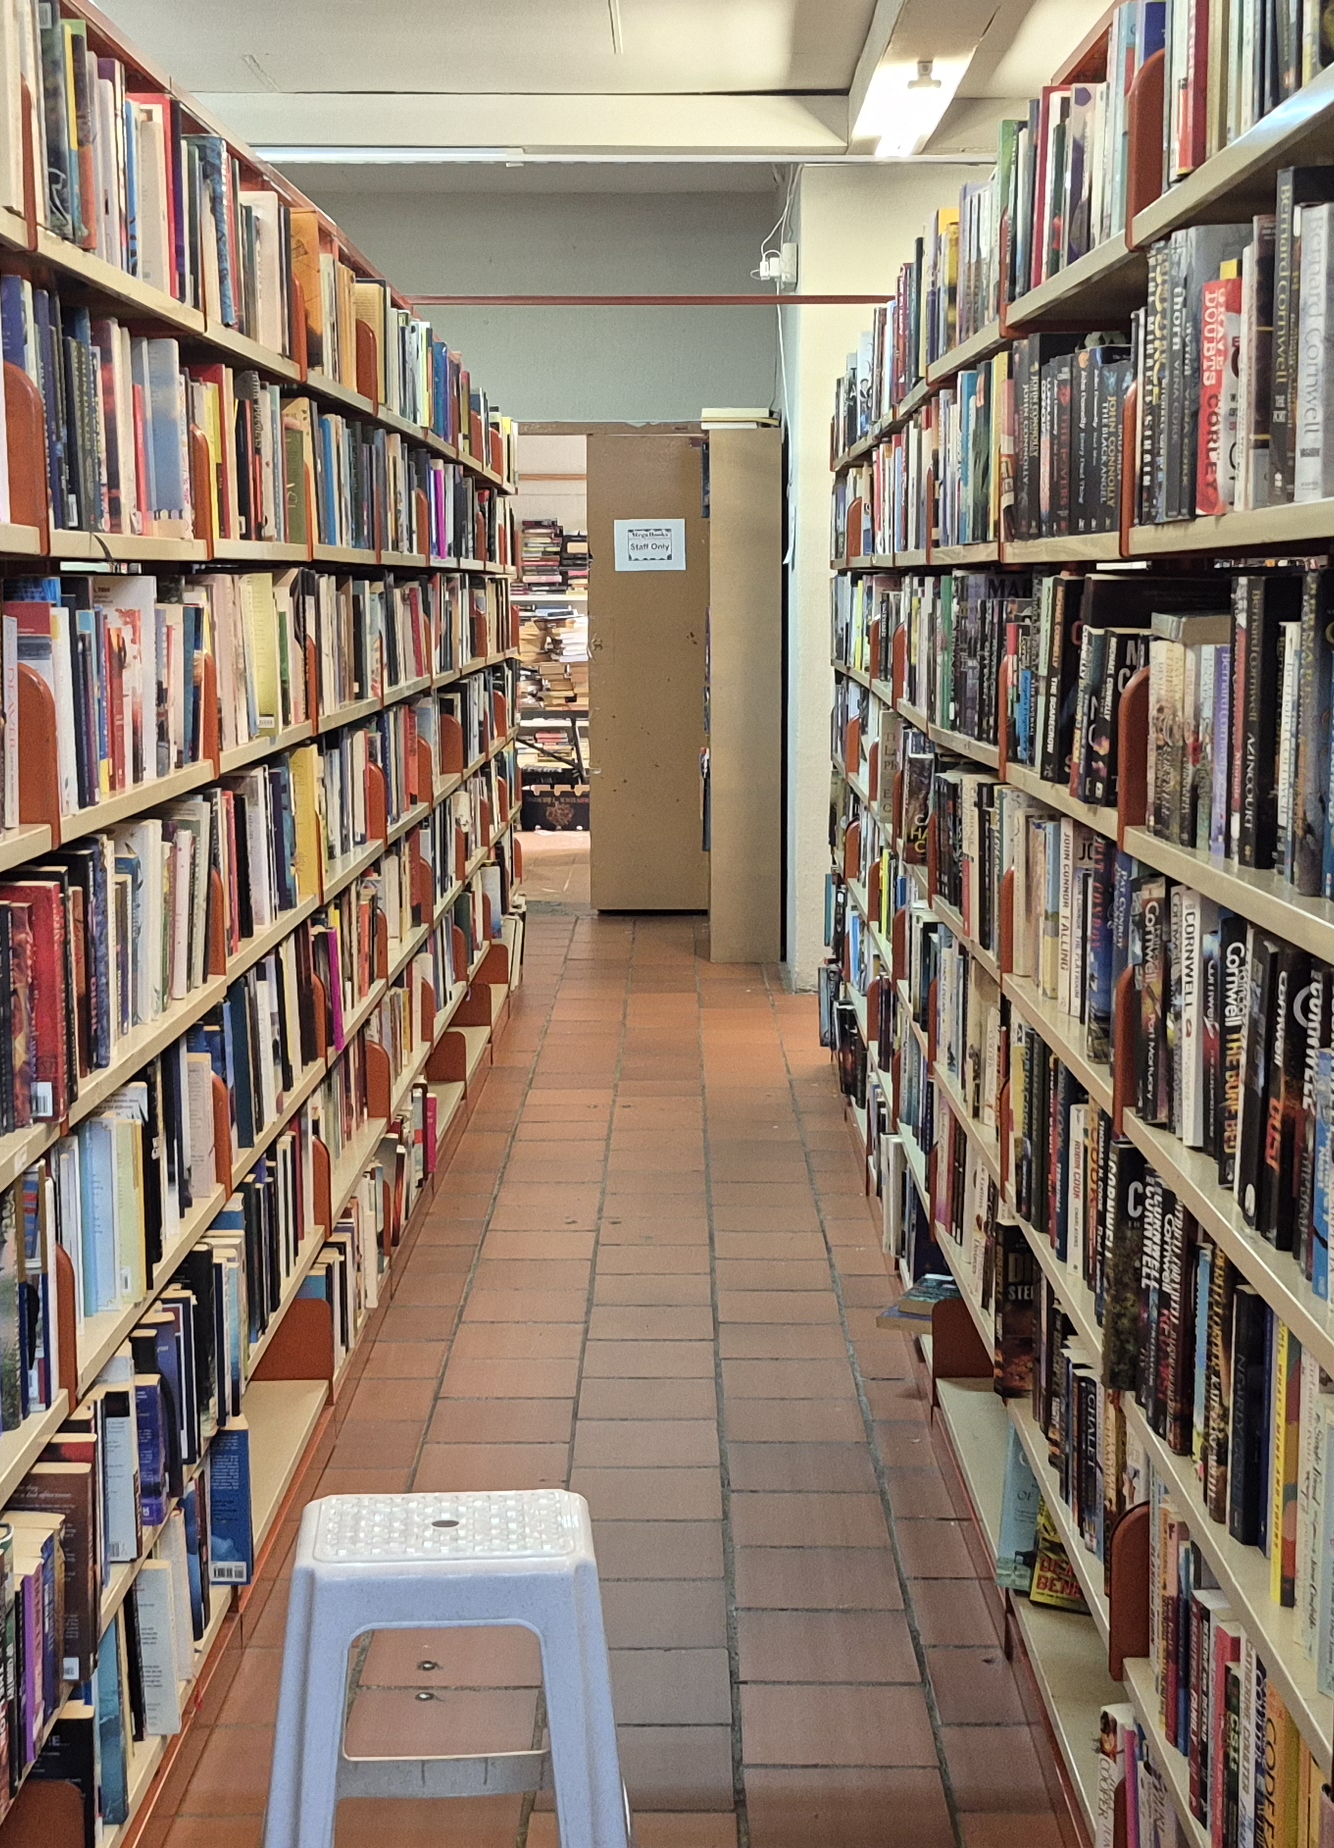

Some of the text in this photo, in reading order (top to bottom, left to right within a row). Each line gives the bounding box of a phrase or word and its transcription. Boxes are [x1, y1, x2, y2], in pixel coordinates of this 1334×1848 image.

[1274, 184, 1293, 385] Bernard Cornwell
[1202, 290, 1218, 386] DOUBTS
[1303, 328, 1322, 438] Cornwell
[1100, 402, 1109, 504] THE BLACK ANGEL
[1107, 396, 1117, 508] JOHN CONNOLLY
[1205, 393, 1220, 491] CORLEY
[630, 543, 669, 552] Staff Only
[1106, 637, 1117, 675] MICHAEL
[1047, 677, 1058, 754] THE SCARECROW
[1244, 732, 1256, 833] AZINCOURT
[1060, 831, 1072, 972] JOHN FALLING
[1143, 900, 1161, 1038] Cornwell Port
[1181, 910, 1197, 1014] CORNWELL
[1223, 941, 1247, 1154] Cornwell THE BED
[1271, 970, 1289, 1067] Cornwell
[1073, 1171, 1082, 1200] COOK
[1084, 1392, 1099, 1471] CHALET
